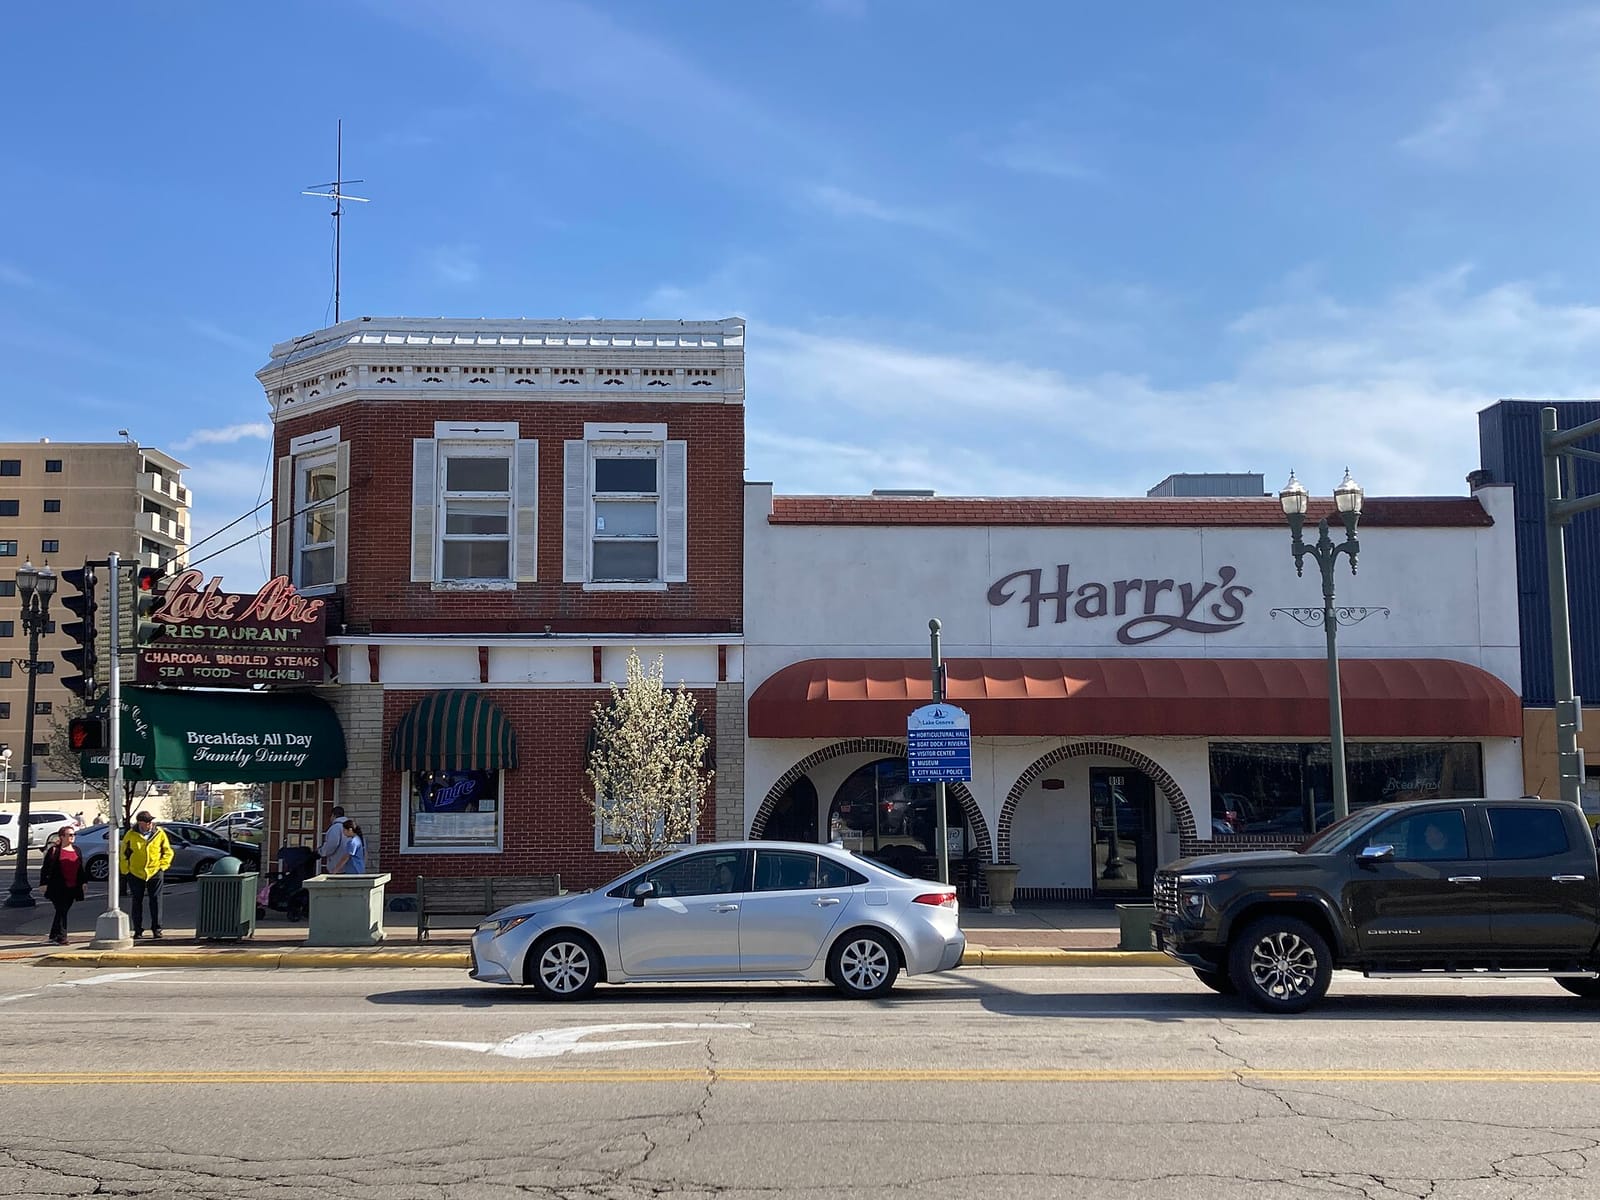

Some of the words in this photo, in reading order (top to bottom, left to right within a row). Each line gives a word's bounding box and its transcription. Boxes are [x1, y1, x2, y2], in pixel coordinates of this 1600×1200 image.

[151, 569, 241, 623] Lake
[237, 575, 325, 623] Aire
[987, 564, 1253, 645] Harry's
[164, 625, 302, 642] RESTAURANT
[144, 652, 211, 665] CHARCOAL
[216, 654, 269, 666] BROILED
[274, 656, 320, 667] STEAKS
[159, 667, 185, 678] SEA
[246, 669, 305, 680] CHICKEN
[186, 731, 260, 745] Breakfast
[263, 733, 282, 746] All
[285, 733, 313, 748] Day
[121, 752, 131, 766] All
[131, 752, 146, 769] Day
[193, 746, 253, 768] Family
[255, 747, 310, 768] Dining
